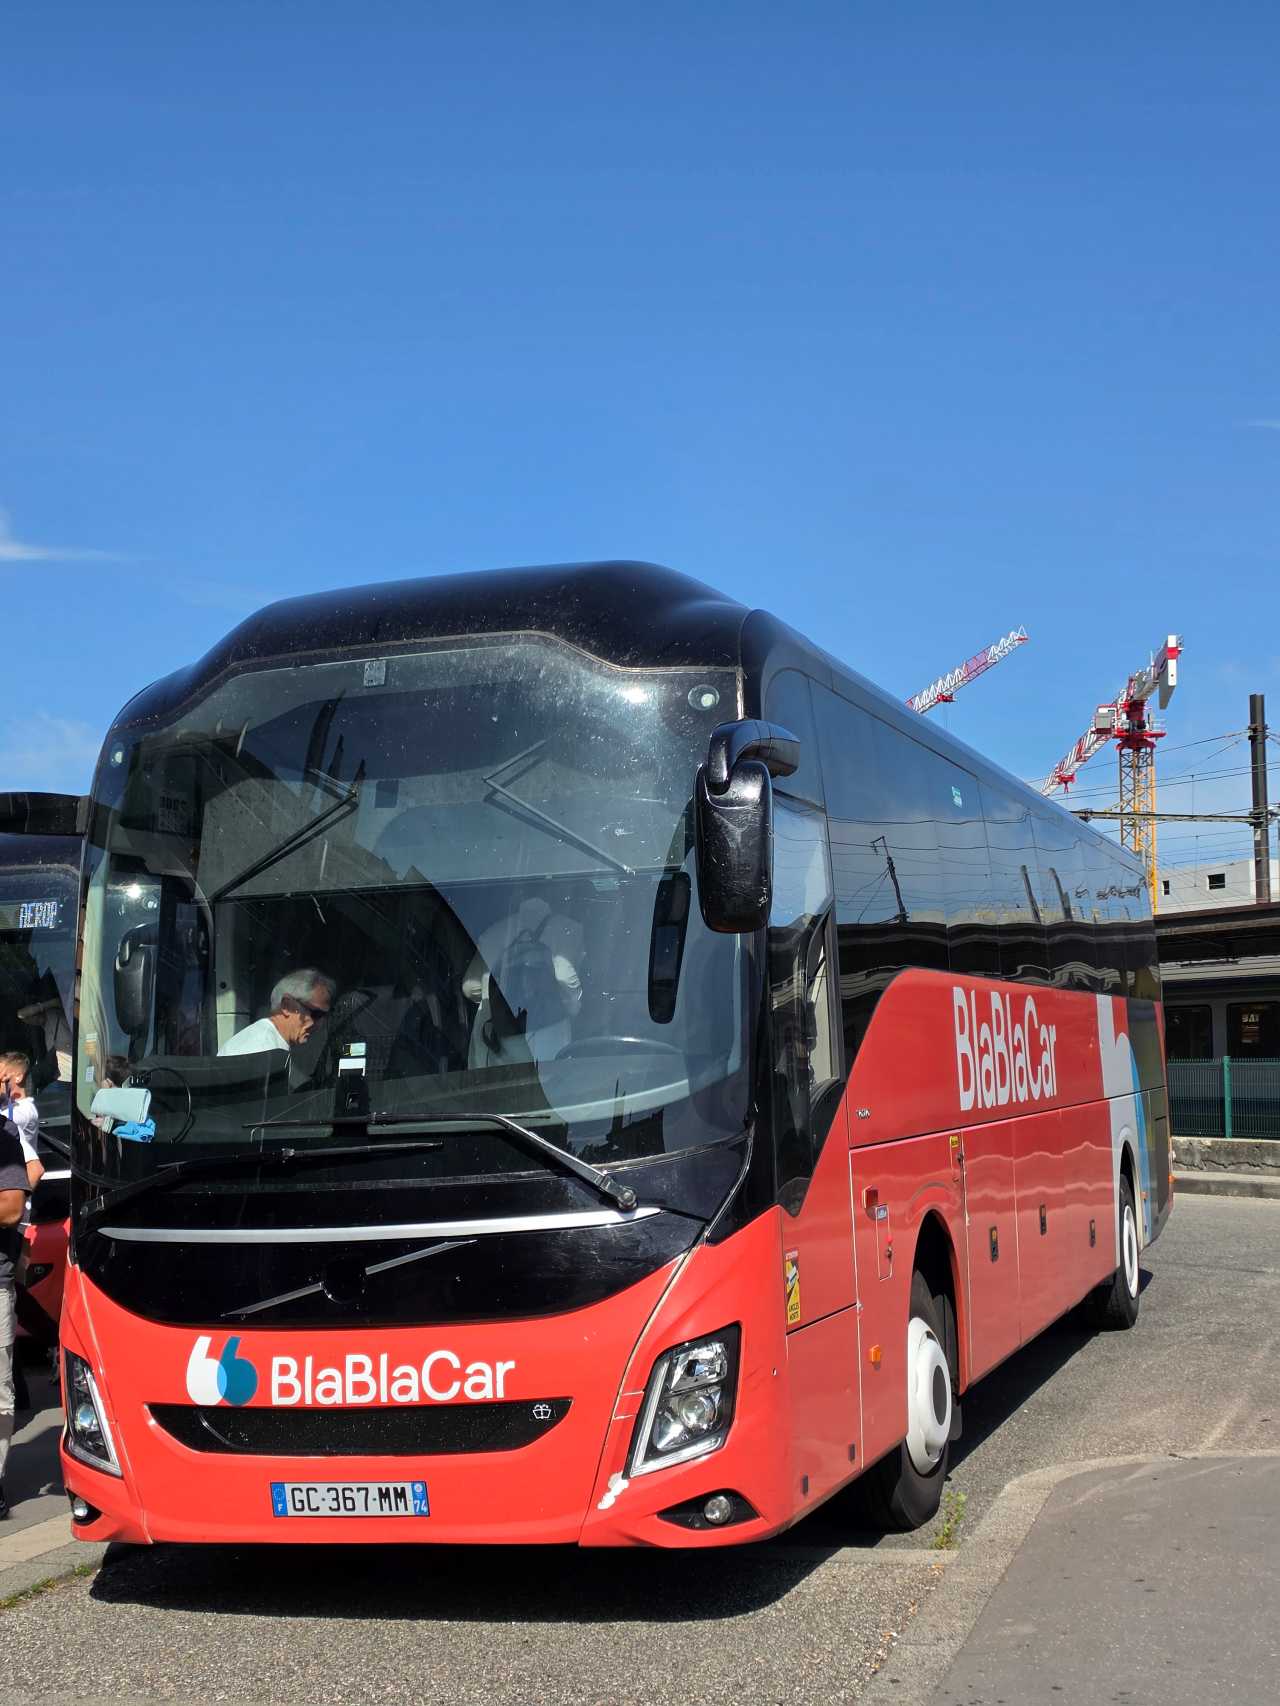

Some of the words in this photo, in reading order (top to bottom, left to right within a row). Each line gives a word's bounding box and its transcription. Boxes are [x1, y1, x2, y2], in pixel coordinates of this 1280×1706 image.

[953, 986, 1057, 1111] BlaBlaCar
[272, 1350, 515, 1405] BlaBlaCar
[277, 1503, 283, 1511] F
[413, 1500, 428, 1513] 74
